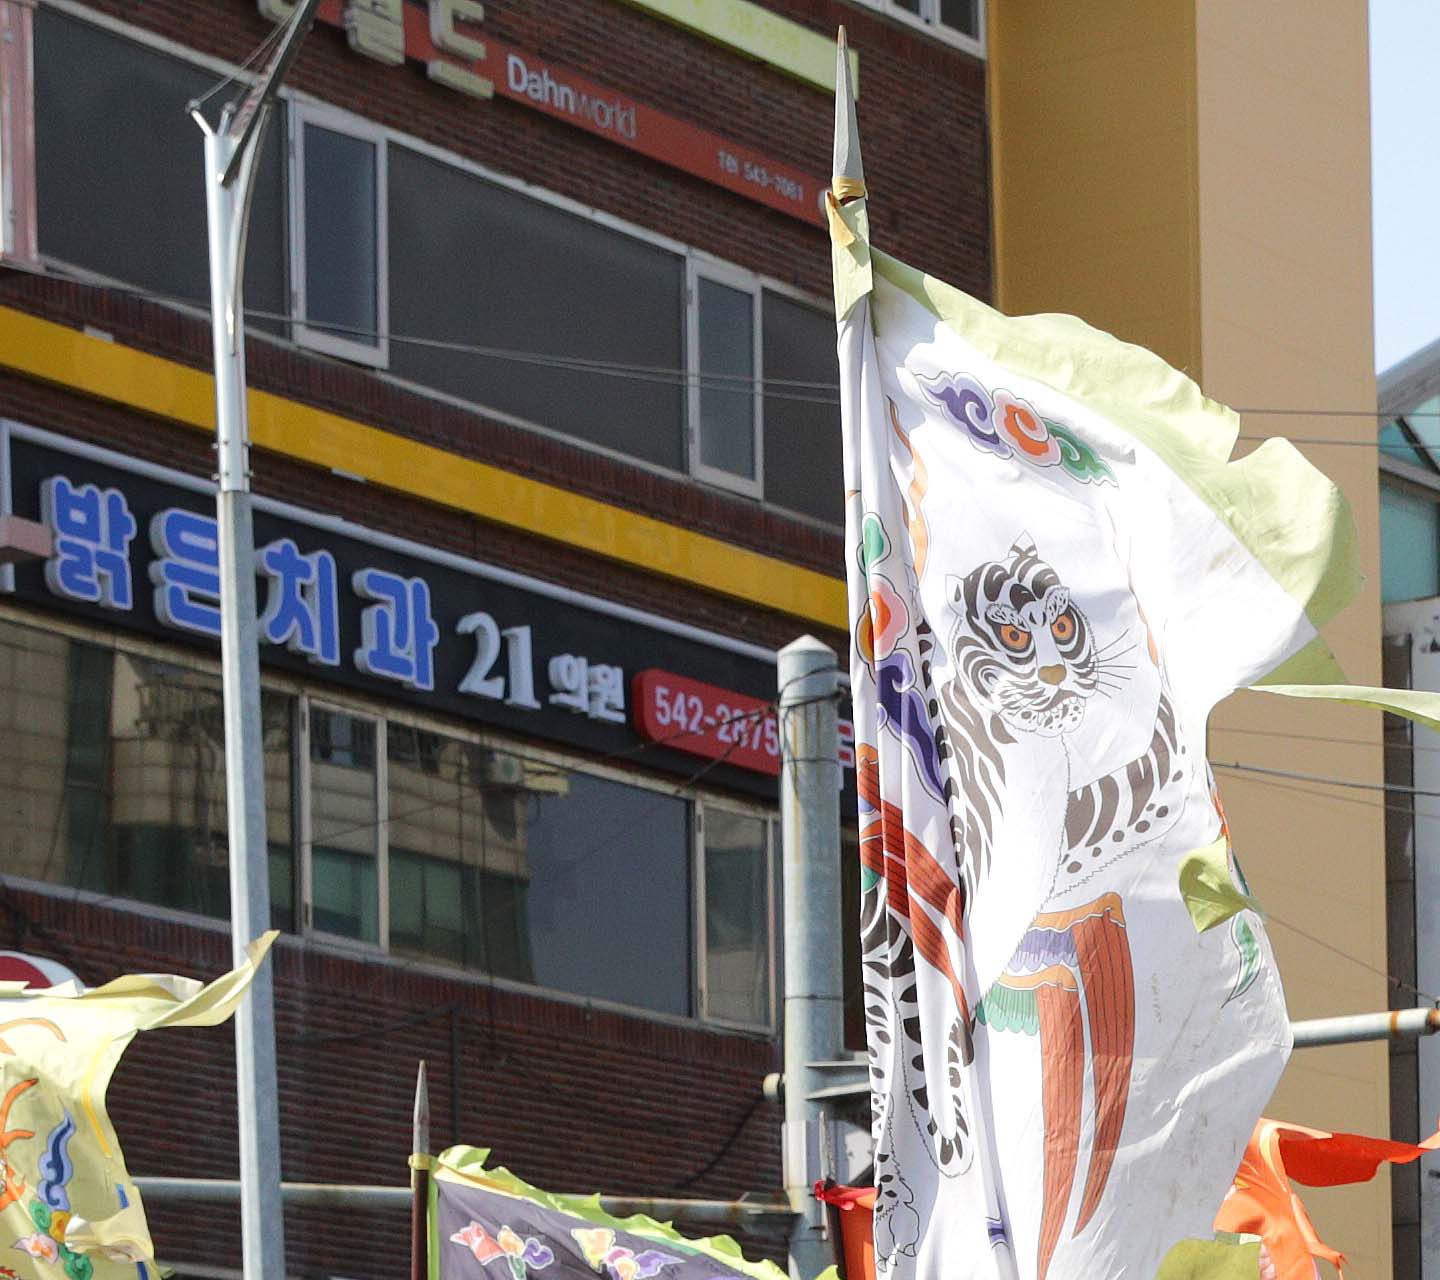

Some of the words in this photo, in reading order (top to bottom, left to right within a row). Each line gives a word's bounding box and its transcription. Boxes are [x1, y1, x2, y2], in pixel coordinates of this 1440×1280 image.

[506, 54, 638, 141] Dahnworld
[40, 476, 440, 691] 밝은치과
[456, 612, 541, 710] 21
[549, 653, 627, 724] 의원
